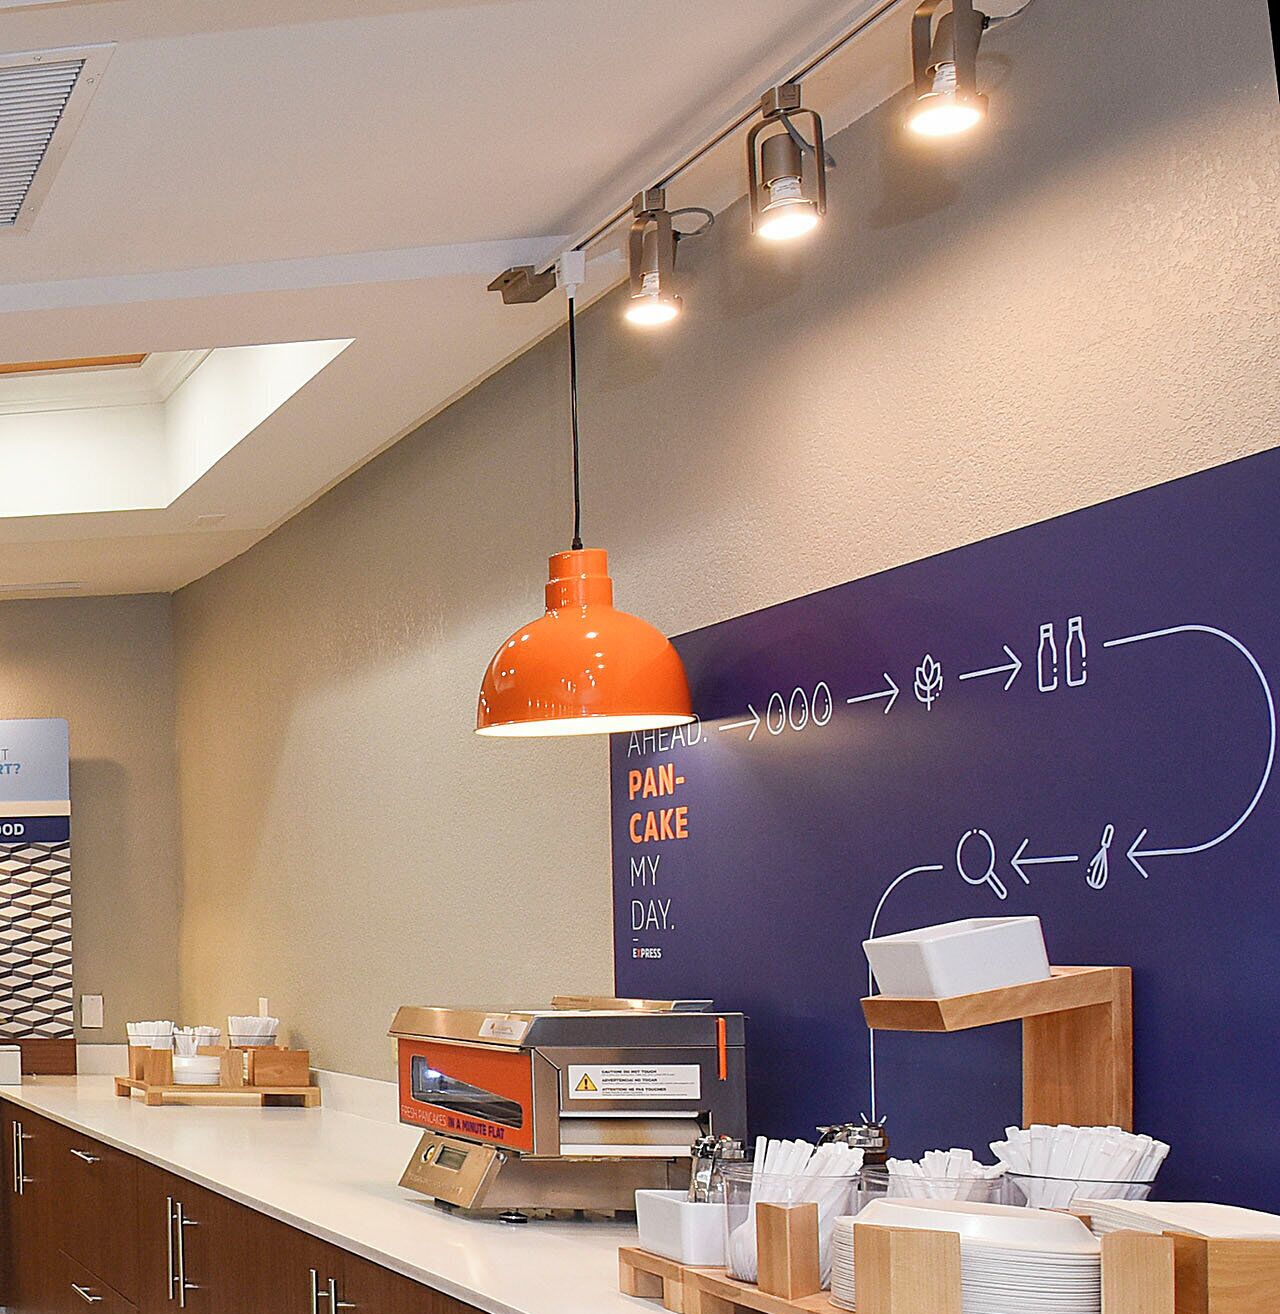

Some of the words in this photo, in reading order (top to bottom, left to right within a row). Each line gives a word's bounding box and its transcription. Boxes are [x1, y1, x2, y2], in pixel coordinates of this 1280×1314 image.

[627, 713, 707, 758] AHEAD.
[628, 762, 686, 801] PAN-
[629, 806, 689, 844] CAKE
[630, 854, 661, 887] MY
[631, 898, 675, 931] DAY.
[632, 948, 661, 959] EXPRESS
[463, 1120, 487, 1136] MINUTE
[488, 1125, 505, 1140] FLAT
